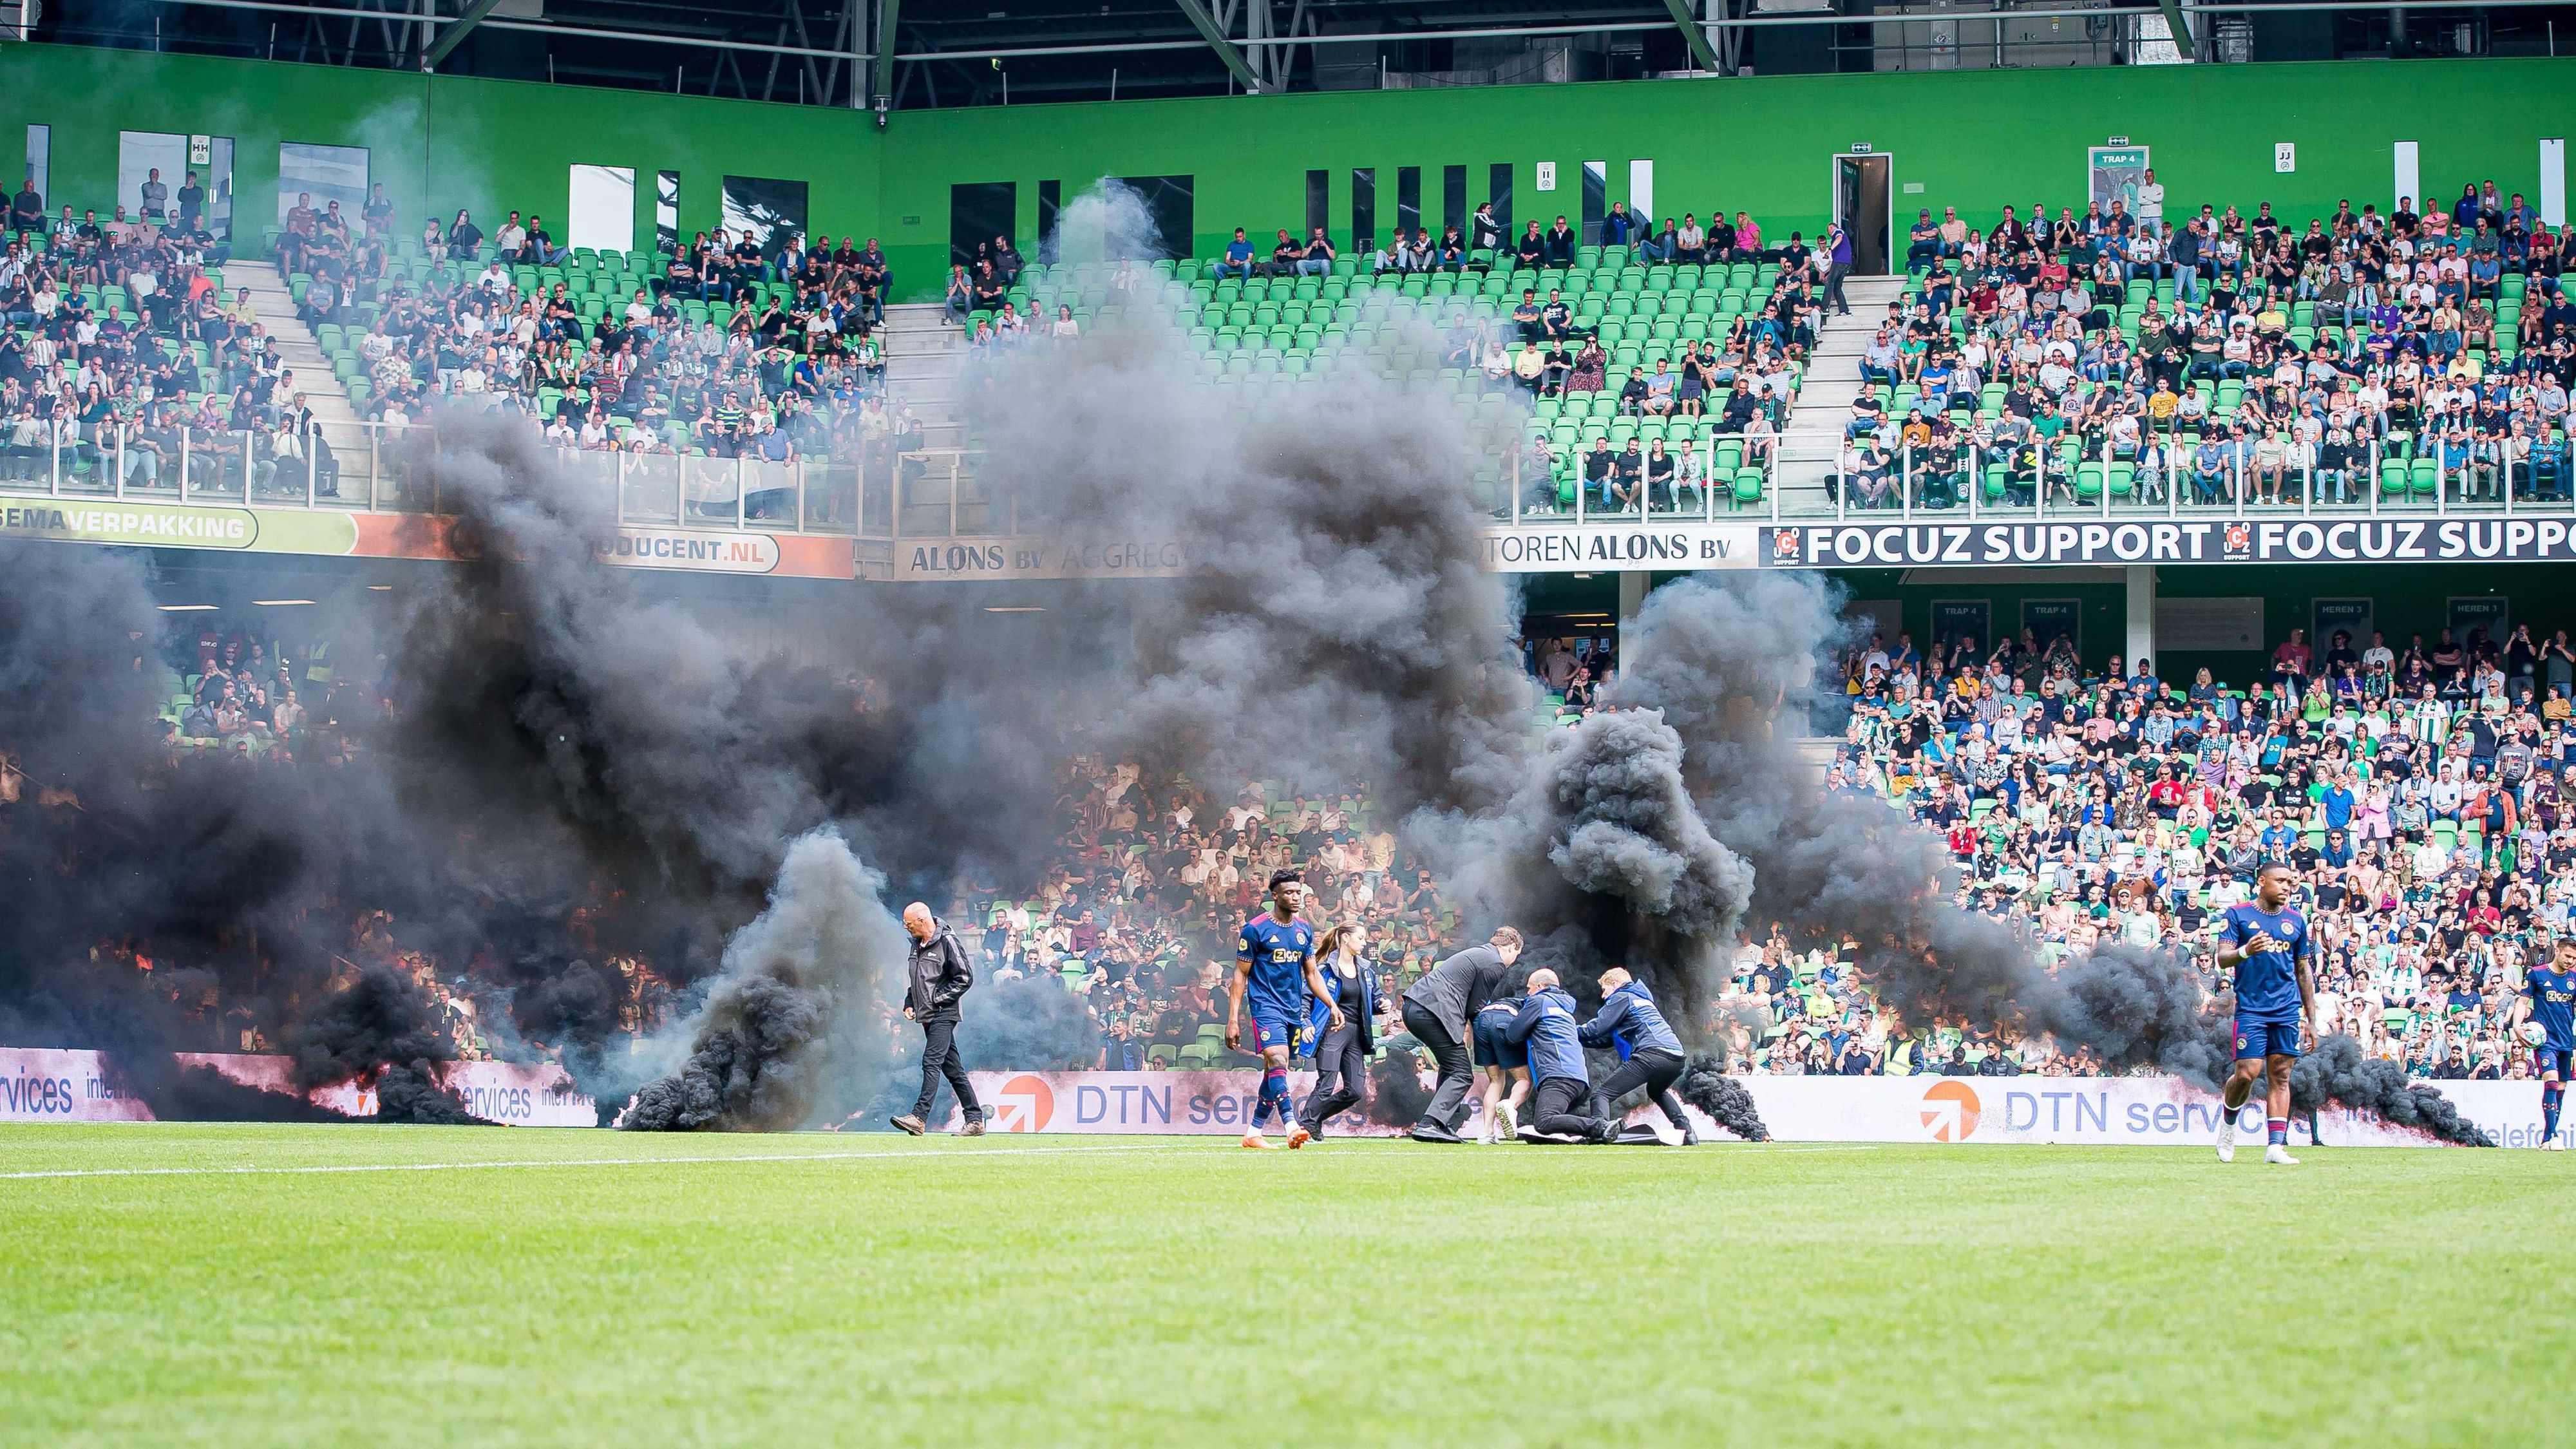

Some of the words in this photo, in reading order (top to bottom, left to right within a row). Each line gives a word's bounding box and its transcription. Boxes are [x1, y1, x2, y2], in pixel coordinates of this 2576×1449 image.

[193, 144, 209, 152] HH
[0, 507, 245, 539] EMAVERPAKKING
[1481, 536, 1580, 562] TOREN
[1589, 534, 1688, 560] ALONS
[1700, 540, 1731, 559] BV
[1807, 526, 1973, 564] FOCUZ
[1984, 523, 2211, 563] SUPPORT
[2259, 522, 2427, 560] FOCUZ
[910, 545, 1005, 573] ALONS
[1076, 1084, 1172, 1124] DTN
[2007, 1091, 2107, 1133] DTN
